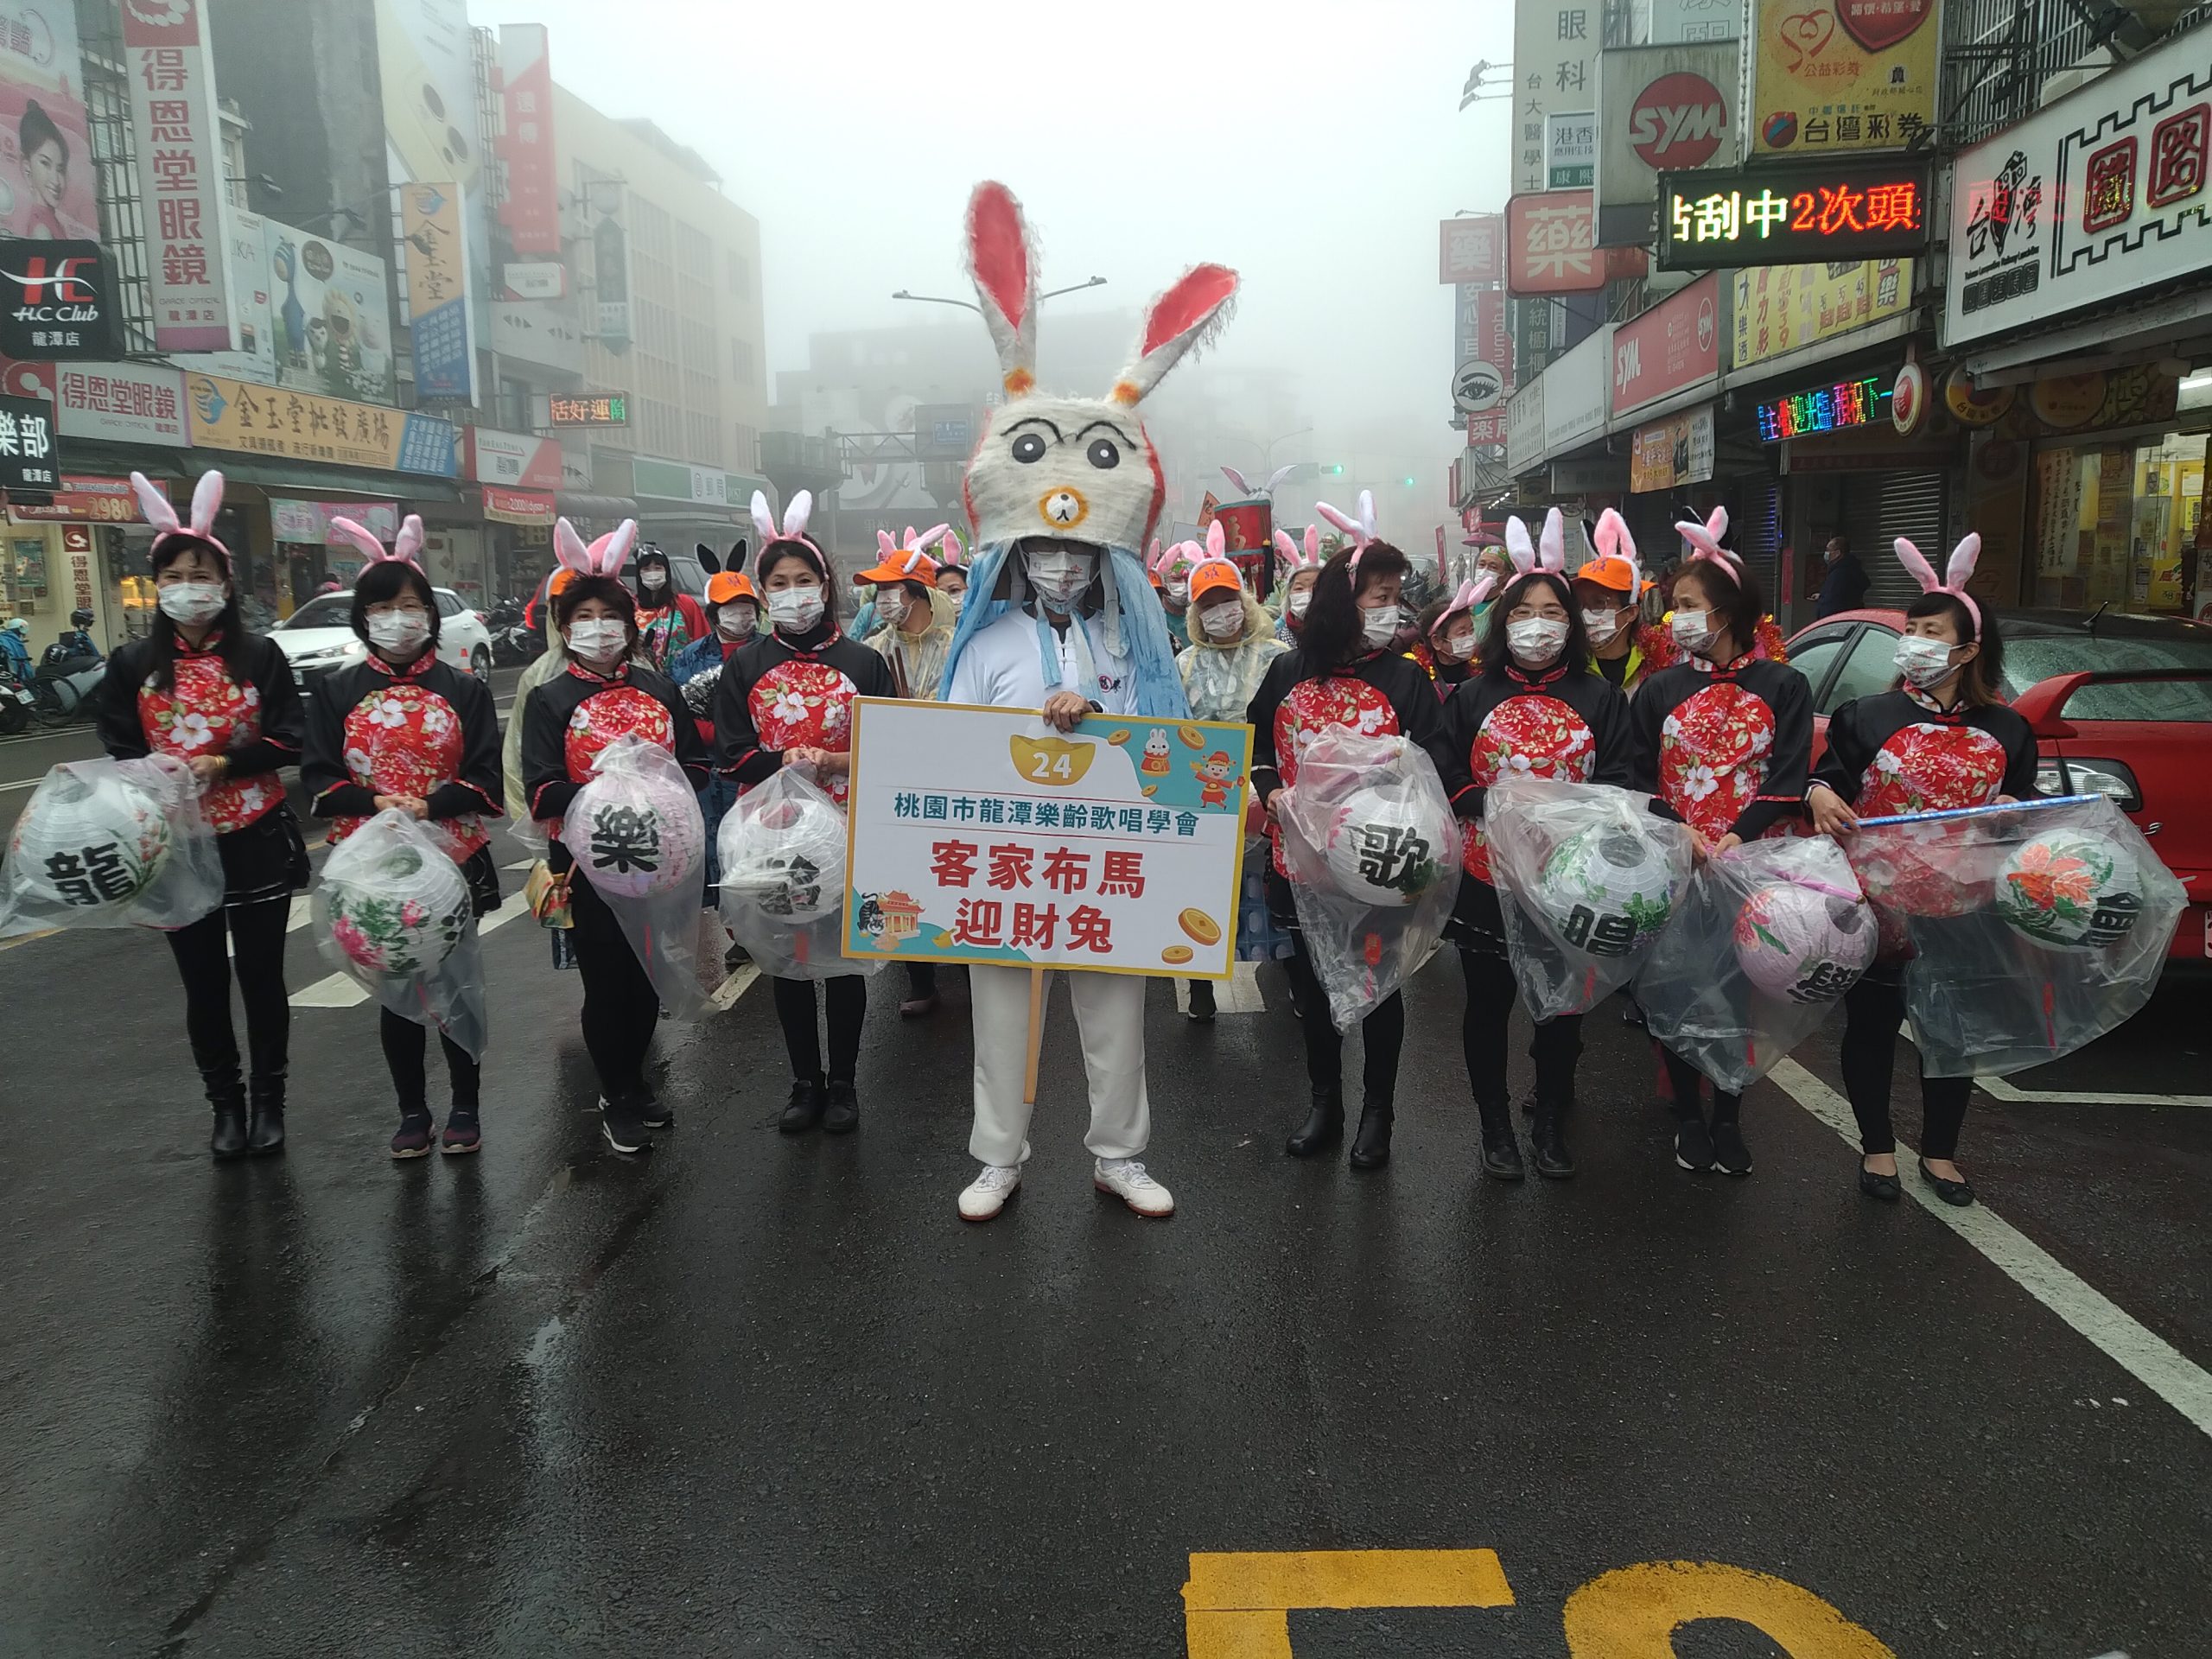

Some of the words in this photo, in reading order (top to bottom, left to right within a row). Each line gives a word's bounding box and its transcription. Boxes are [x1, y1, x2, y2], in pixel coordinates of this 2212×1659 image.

[1555, 10, 1588, 92] 眼科
[1523, 73, 1543, 190] 台大醫學士
[1630, 103, 1726, 155] SYM
[140, 48, 210, 285] 得恩堂眼鏡
[1524, 204, 1592, 279] 藥
[31, 331, 80, 347] 龍潭店
[1491, 311, 1505, 369] riumph
[1528, 297, 1548, 378] 統櫥櫃
[1617, 337, 1642, 396] SYM
[61, 372, 179, 422] 得恩堂眼鏡
[86, 497, 132, 521] 2980
[1031, 752, 1072, 779] 24
[590, 803, 660, 874] 樂
[893, 791, 1199, 837] 桃園市龍潭樂齡歌唱學會
[44, 841, 137, 907] 龍
[929, 839, 1147, 899] 客家布馬
[1357, 823, 1431, 890] 歌
[953, 898, 1115, 954] 迎財兔
[1562, 903, 1638, 958] 唱
